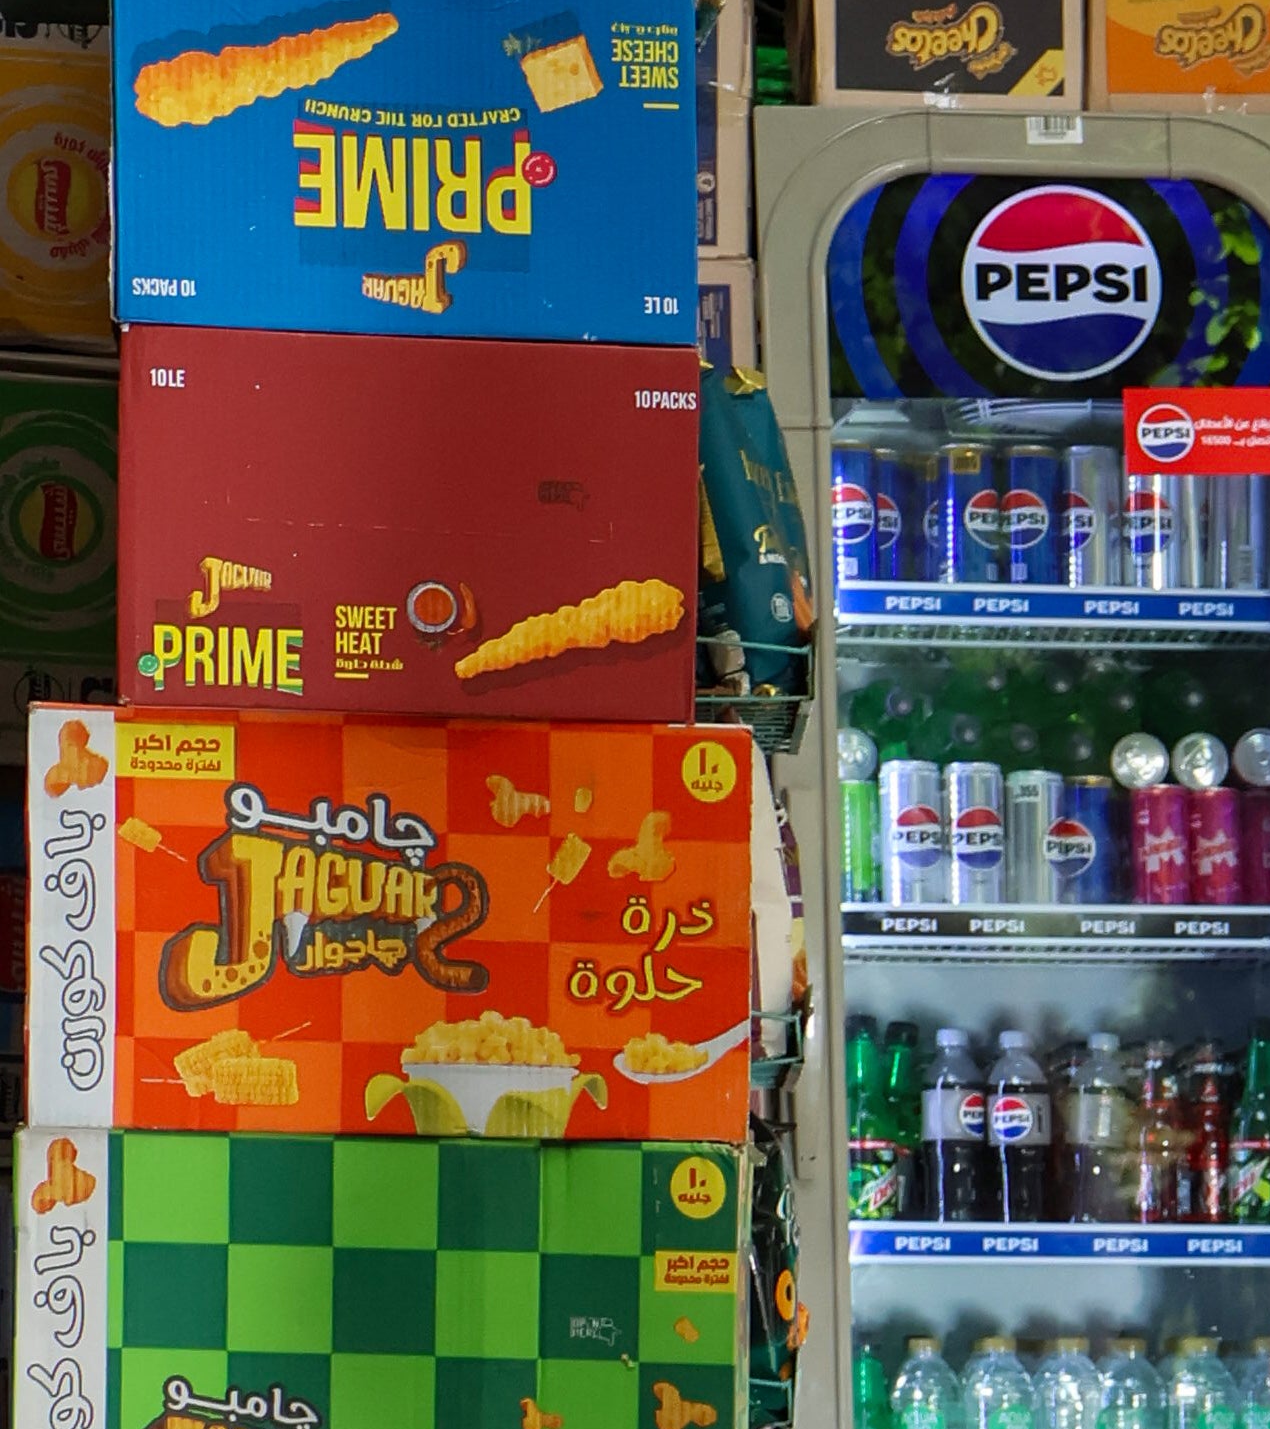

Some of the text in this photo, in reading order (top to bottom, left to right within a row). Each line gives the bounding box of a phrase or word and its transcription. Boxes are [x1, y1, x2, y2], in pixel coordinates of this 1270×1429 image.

[610, 38, 680, 63] CHEESE
[618, 65, 680, 89] SWEET
[304, 99, 372, 123] CRUNCH
[411, 113, 443, 128] FOR
[447, 107, 521, 128] CRAFTED
[294, 130, 533, 235] PRIME
[132, 276, 197, 297] 10 PACKS
[361, 239, 468, 314] JAGUAR
[974, 263, 1149, 304] PEPSI
[643, 295, 680, 316] 10 LE
[149, 367, 186, 388] 10 LE
[633, 389, 697, 410] 10 PACKS
[1141, 426, 1192, 440] PEPSI
[334, 605, 398, 631] SWEET
[884, 595, 1235, 618] PEPSI PEPSI PEPSI PEPSI
[334, 631, 383, 655] HEAT
[153, 623, 304, 693] PRIME
[175, 735, 221, 754] حجم
[129, 757, 222, 773] لفترة محدودة
[162, 831, 445, 1010] JAGUAR
[622, 897, 714, 953] ذرة
[570, 956, 704, 1013] حلوة
[696, 1257, 730, 1273] حجم
